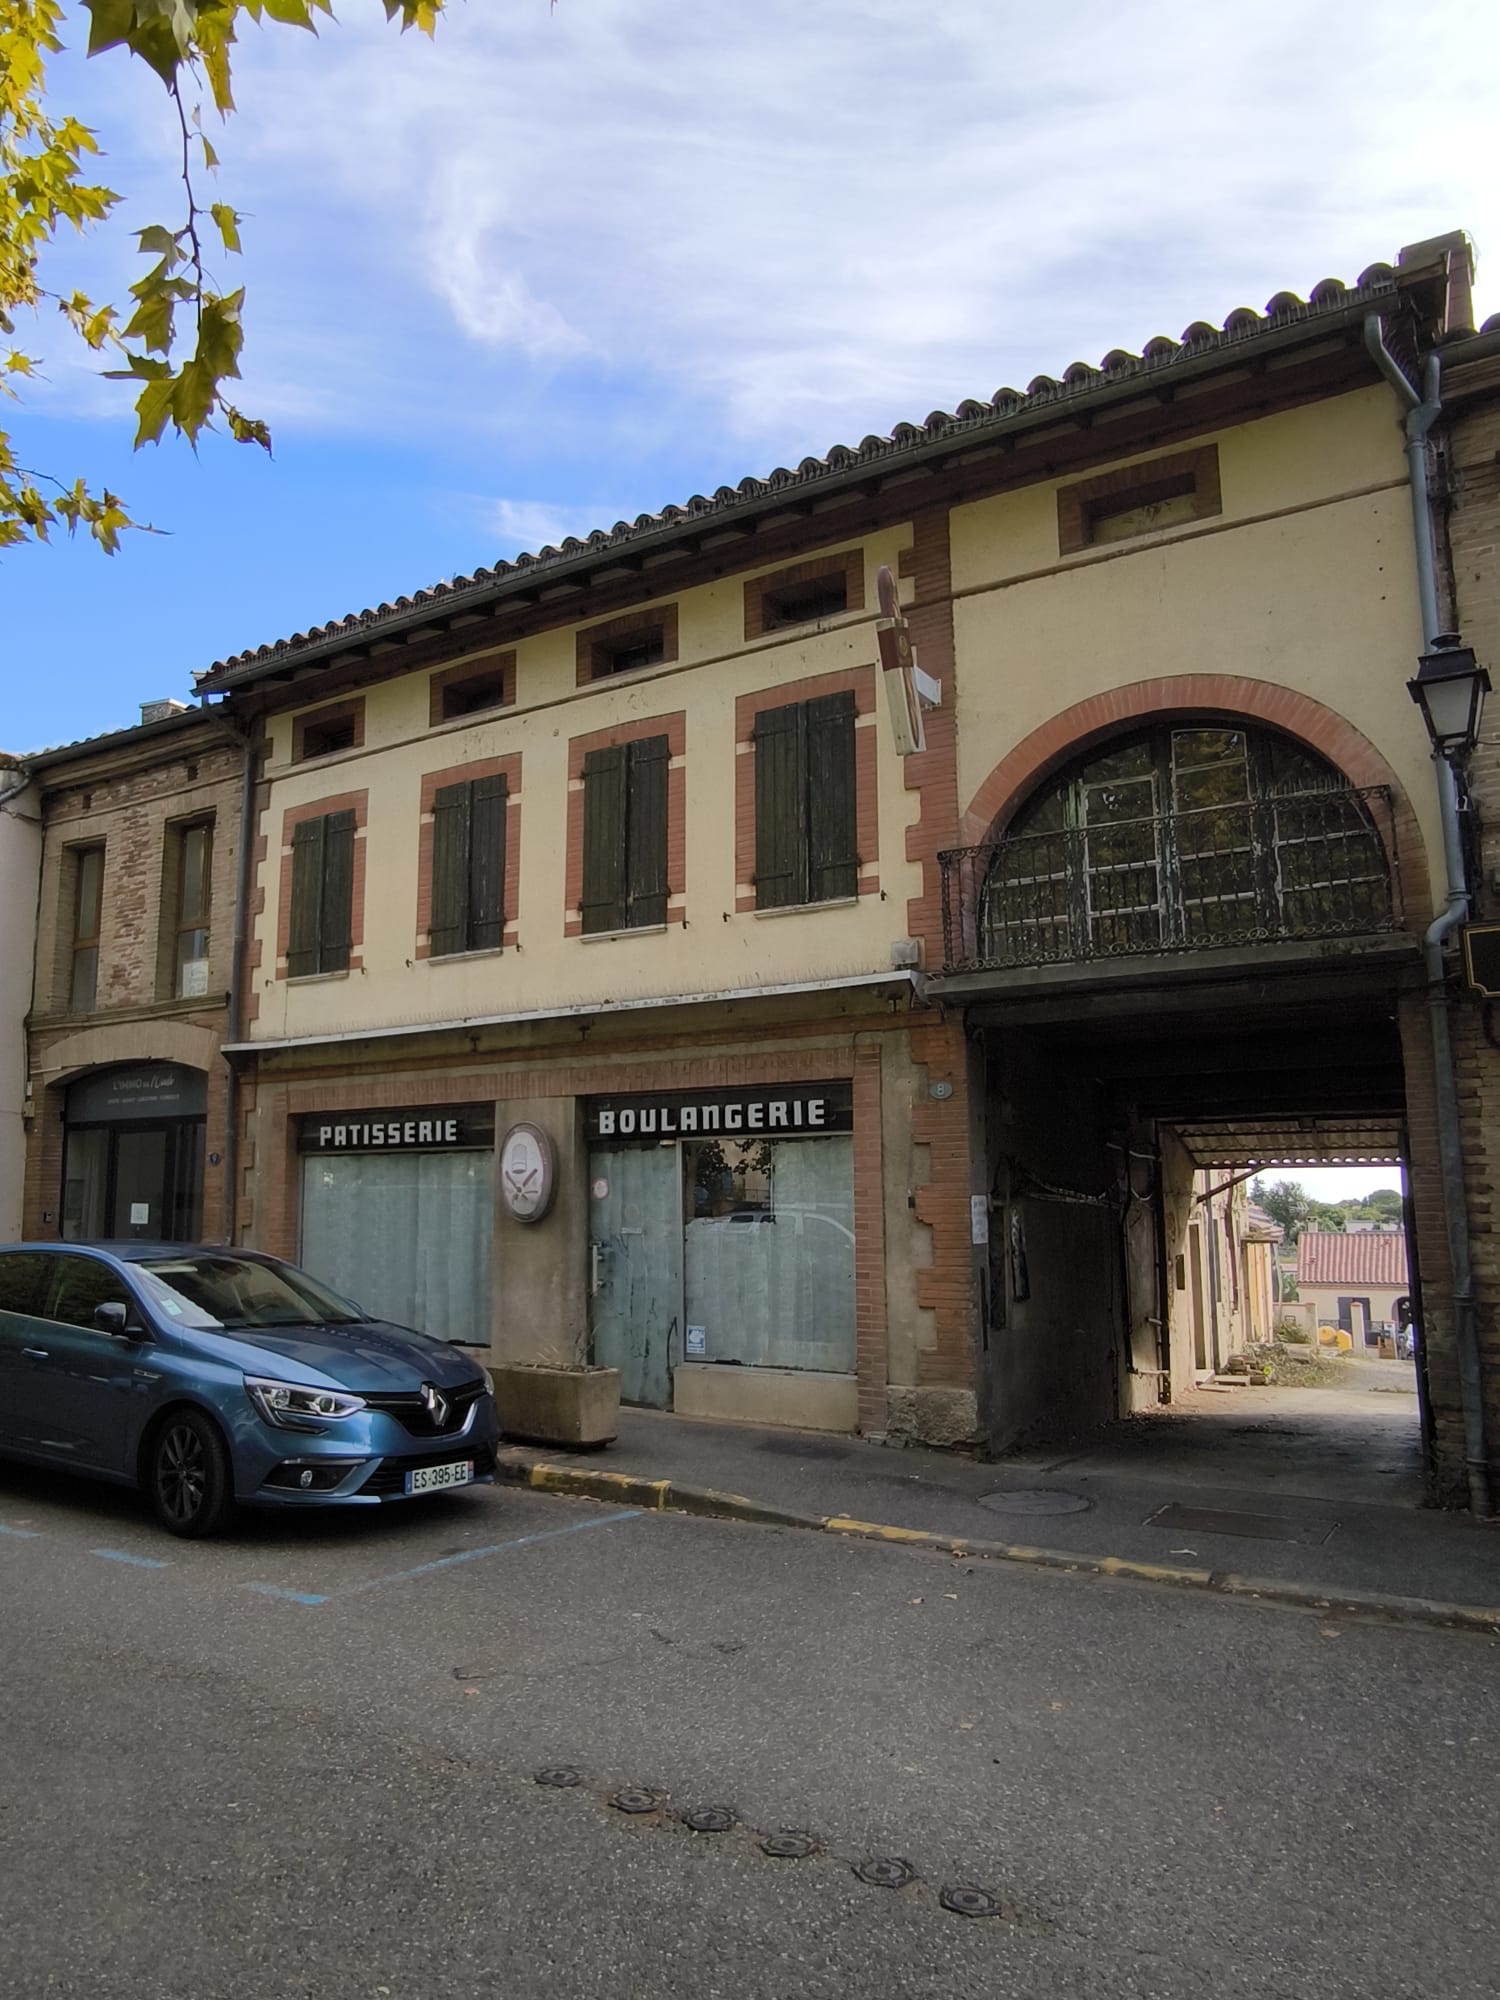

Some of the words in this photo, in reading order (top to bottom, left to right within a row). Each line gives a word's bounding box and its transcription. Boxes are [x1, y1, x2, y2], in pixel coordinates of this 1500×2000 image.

[936, 1083, 945, 1096] 8
[599, 1100, 825, 1134] BOULANGERIE
[320, 1120, 457, 1146] PATISSERIE
[414, 1463, 467, 1489] ES-395-EE
